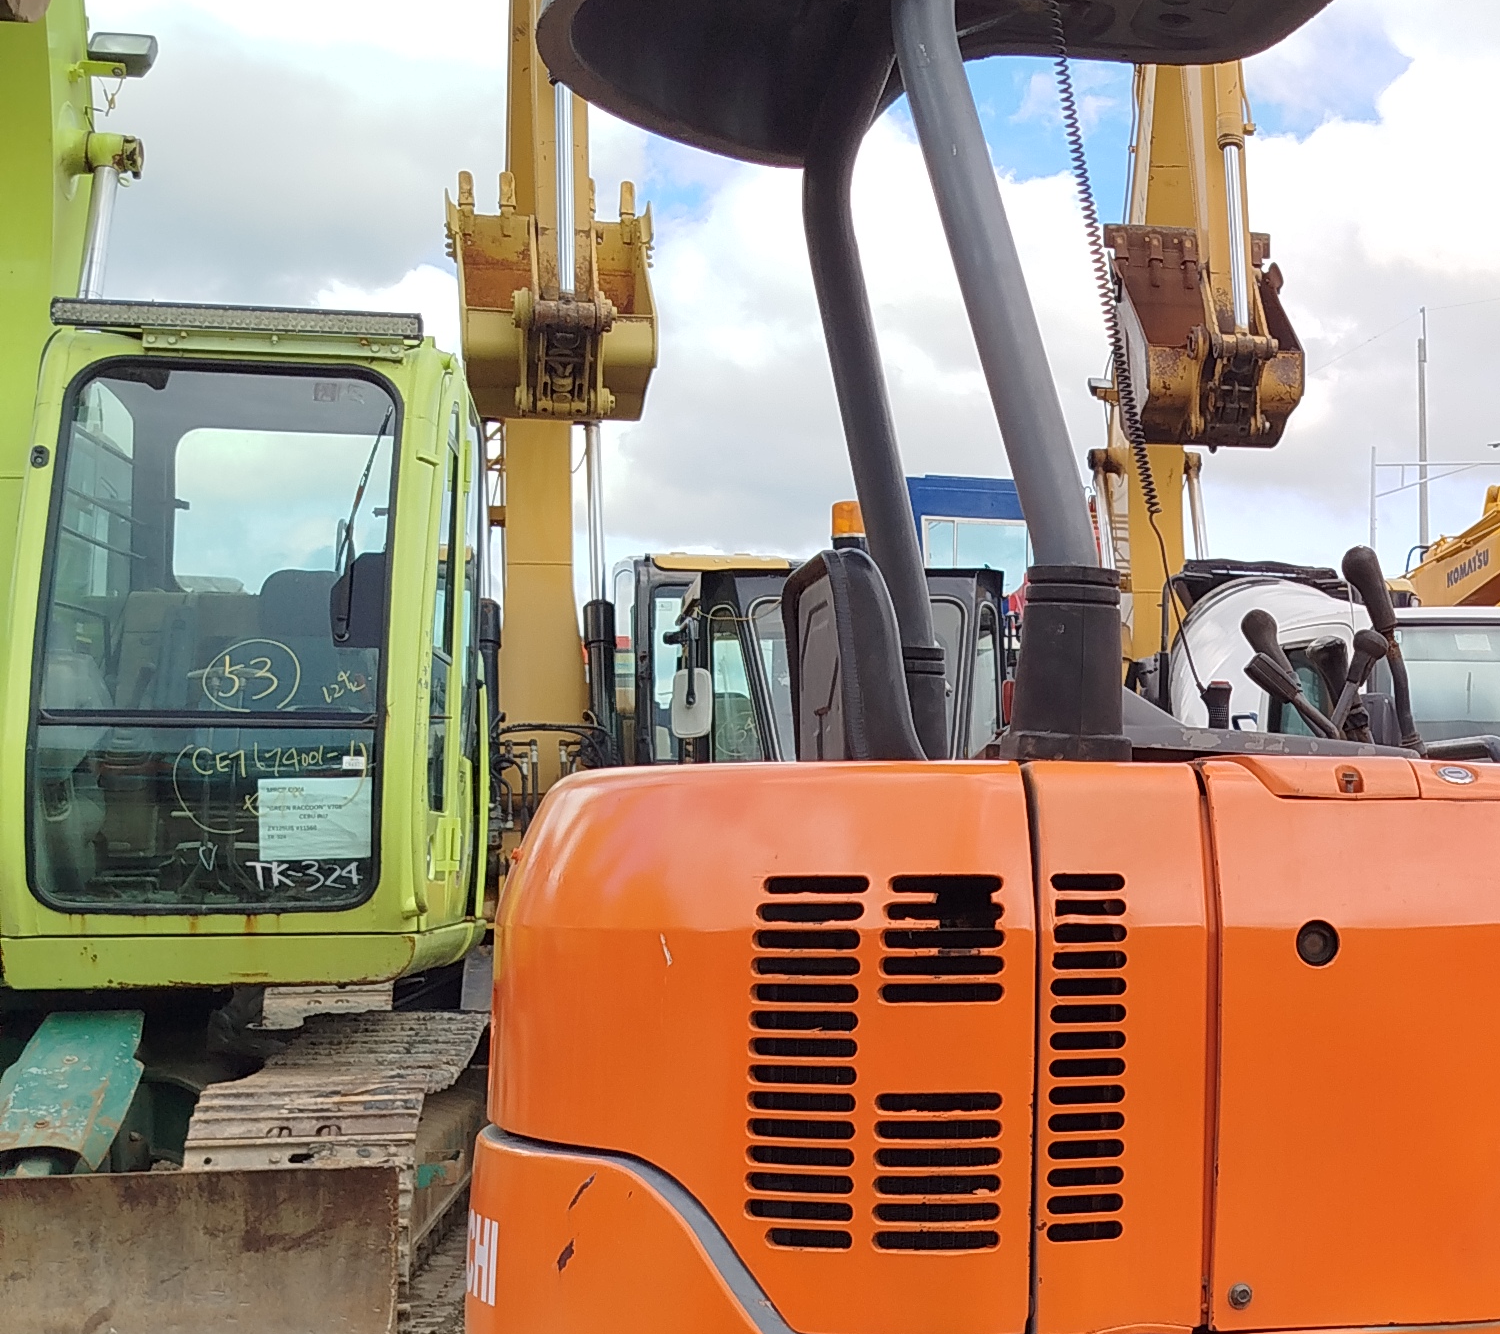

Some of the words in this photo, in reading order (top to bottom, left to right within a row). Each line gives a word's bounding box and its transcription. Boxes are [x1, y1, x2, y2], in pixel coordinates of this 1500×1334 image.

[1446, 548, 1490, 588] KOMATSU
[218, 655, 278, 699] 53
[245, 860, 363, 892] TK-324
